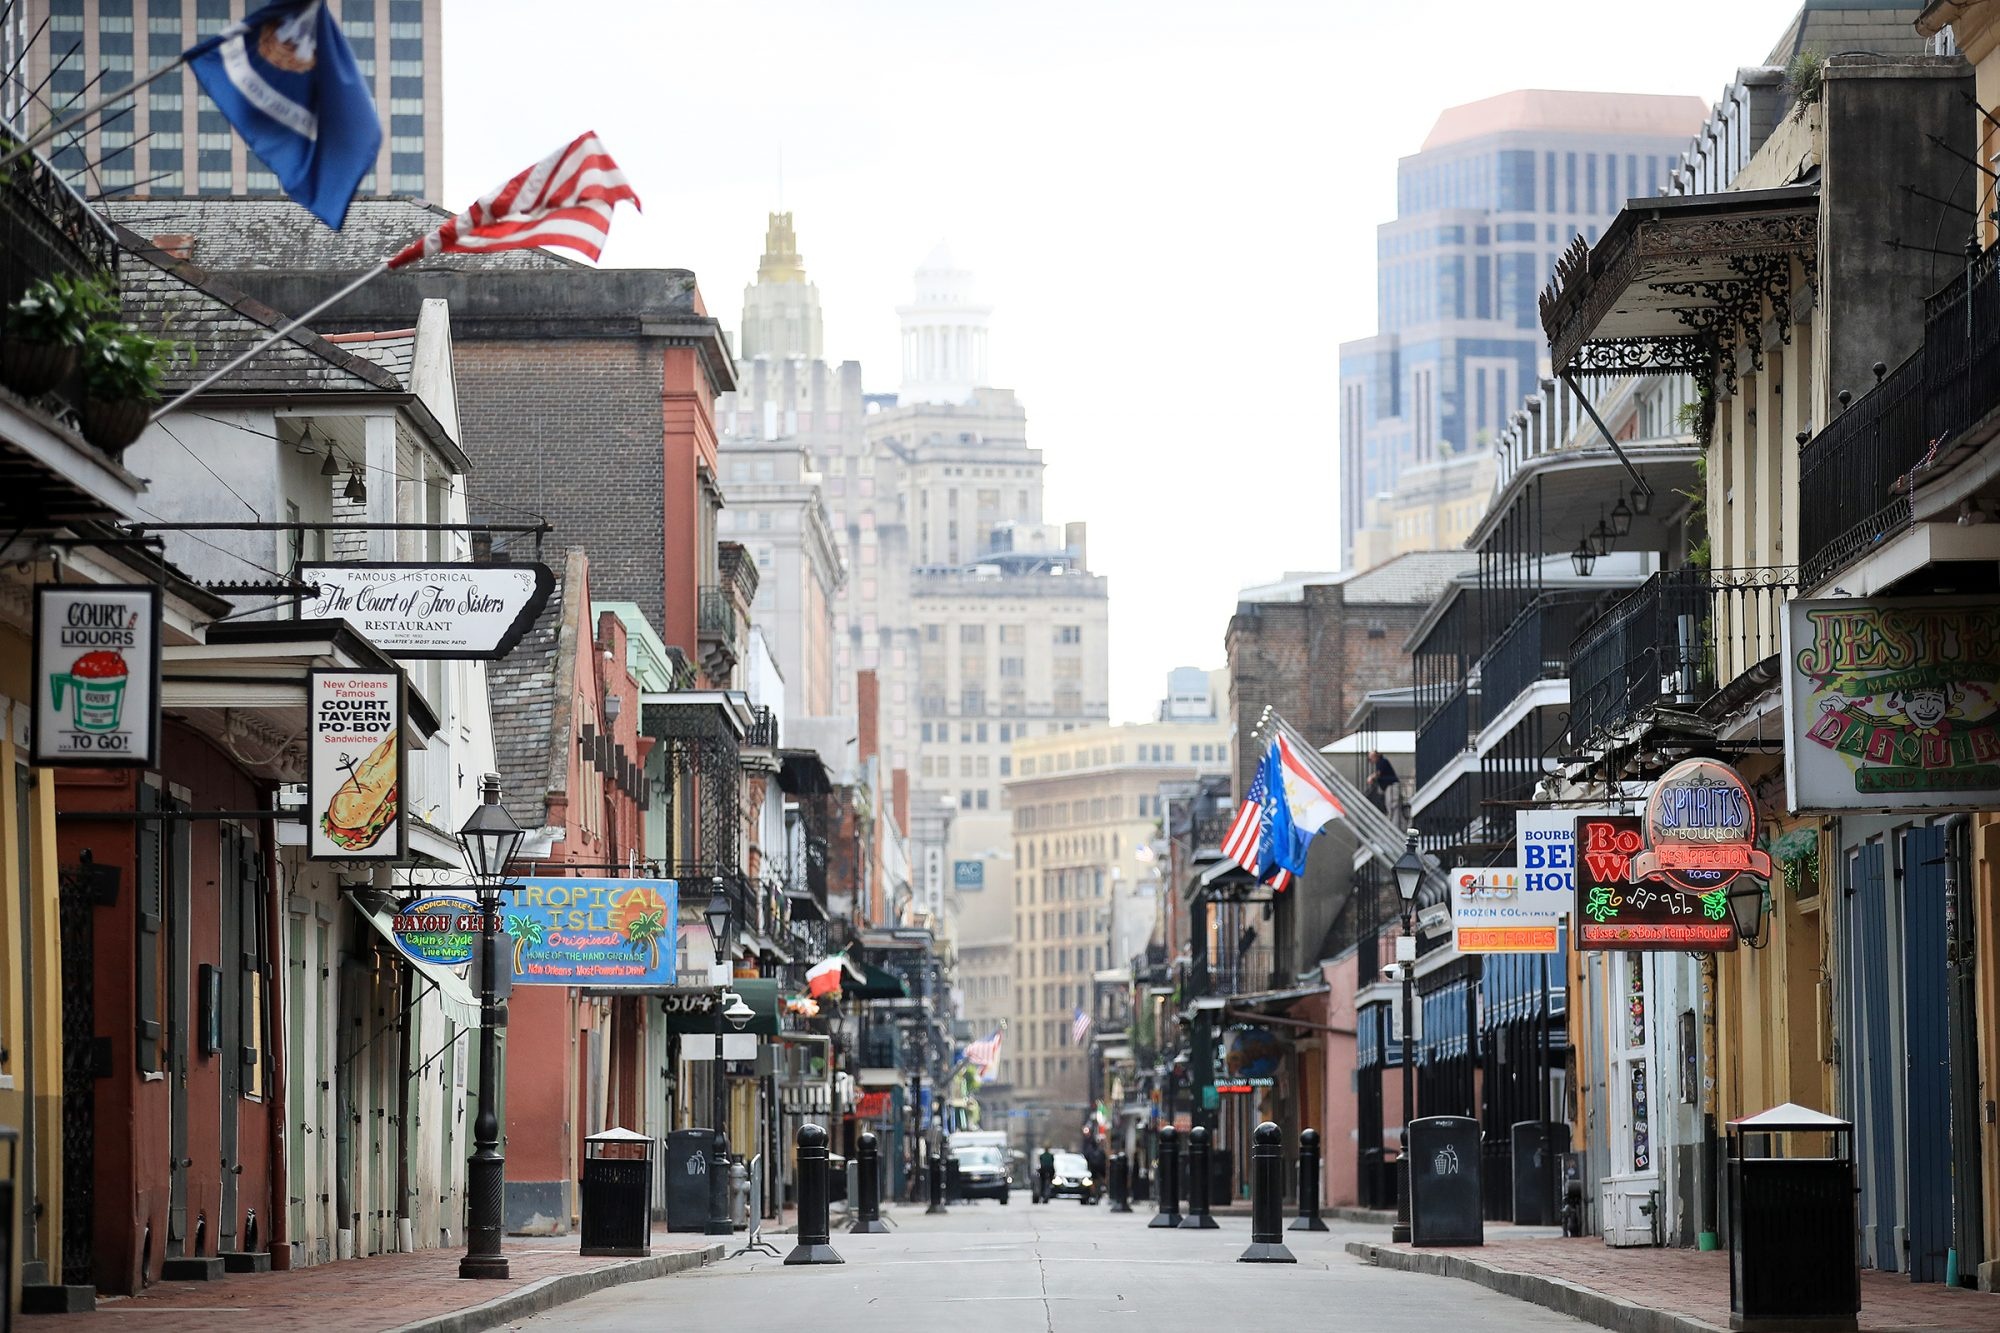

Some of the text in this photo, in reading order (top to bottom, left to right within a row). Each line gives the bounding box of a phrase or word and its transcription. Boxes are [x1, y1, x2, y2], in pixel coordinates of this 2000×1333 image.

[348, 572, 474, 582] FAMOUS HISTORICAL
[314, 583, 505, 619] The Court of Two Sisters
[67, 602, 128, 629] COURT
[365, 620, 452, 631] RESTAURANT
[61, 630, 134, 645] LIQUORS
[1797, 606, 2000, 677] JESTE
[323, 680, 388, 689] New Orleans
[1866, 670, 1928, 692] MARDI
[335, 689, 376, 698] Famous
[322, 700, 388, 710] COURT
[318, 711, 391, 721] TAVERN
[319, 722, 391, 732] PO-BOY
[97, 735, 128, 750] GO!
[324, 735, 378, 743] Sandwiches
[1813, 715, 2000, 765] DAIQUIR
[1862, 771, 1995, 788] AND PIZZA
[1661, 787, 1743, 828] SPIRITS
[1525, 830, 1574, 841] BOURB
[1661, 827, 1745, 842] ON BOURBON
[1525, 844, 1574, 869] BE
[1660, 850, 1748, 864] RESURRECTION
[1460, 874, 1518, 900] SLU
[1525, 873, 1574, 891] HOU
[513, 886, 666, 909] TROPICAL
[414, 900, 474, 914] TROPICAL ISLE'S
[1457, 908, 1497, 917] FROZEN
[392, 914, 452, 933] BAYOU
[546, 910, 626, 932] ISLE
[405, 933, 436, 946] Cajun
[448, 933, 473, 948] Zyde
[1460, 931, 1555, 946] EPIC FRIES
[1585, 925, 1618, 940] Laissez
[1638, 925, 1662, 939] Bons
[1663, 925, 1695, 941] Temps
[1697, 925, 1730, 939] Rouler
[547, 932, 620, 950] Original
[422, 947, 468, 957] Live Music
[527, 951, 645, 962] HOME OF THE HAND GRENADE
[528, 963, 543, 975] New
[576, 964, 594, 976] Most
[666, 994, 713, 1012] 504
